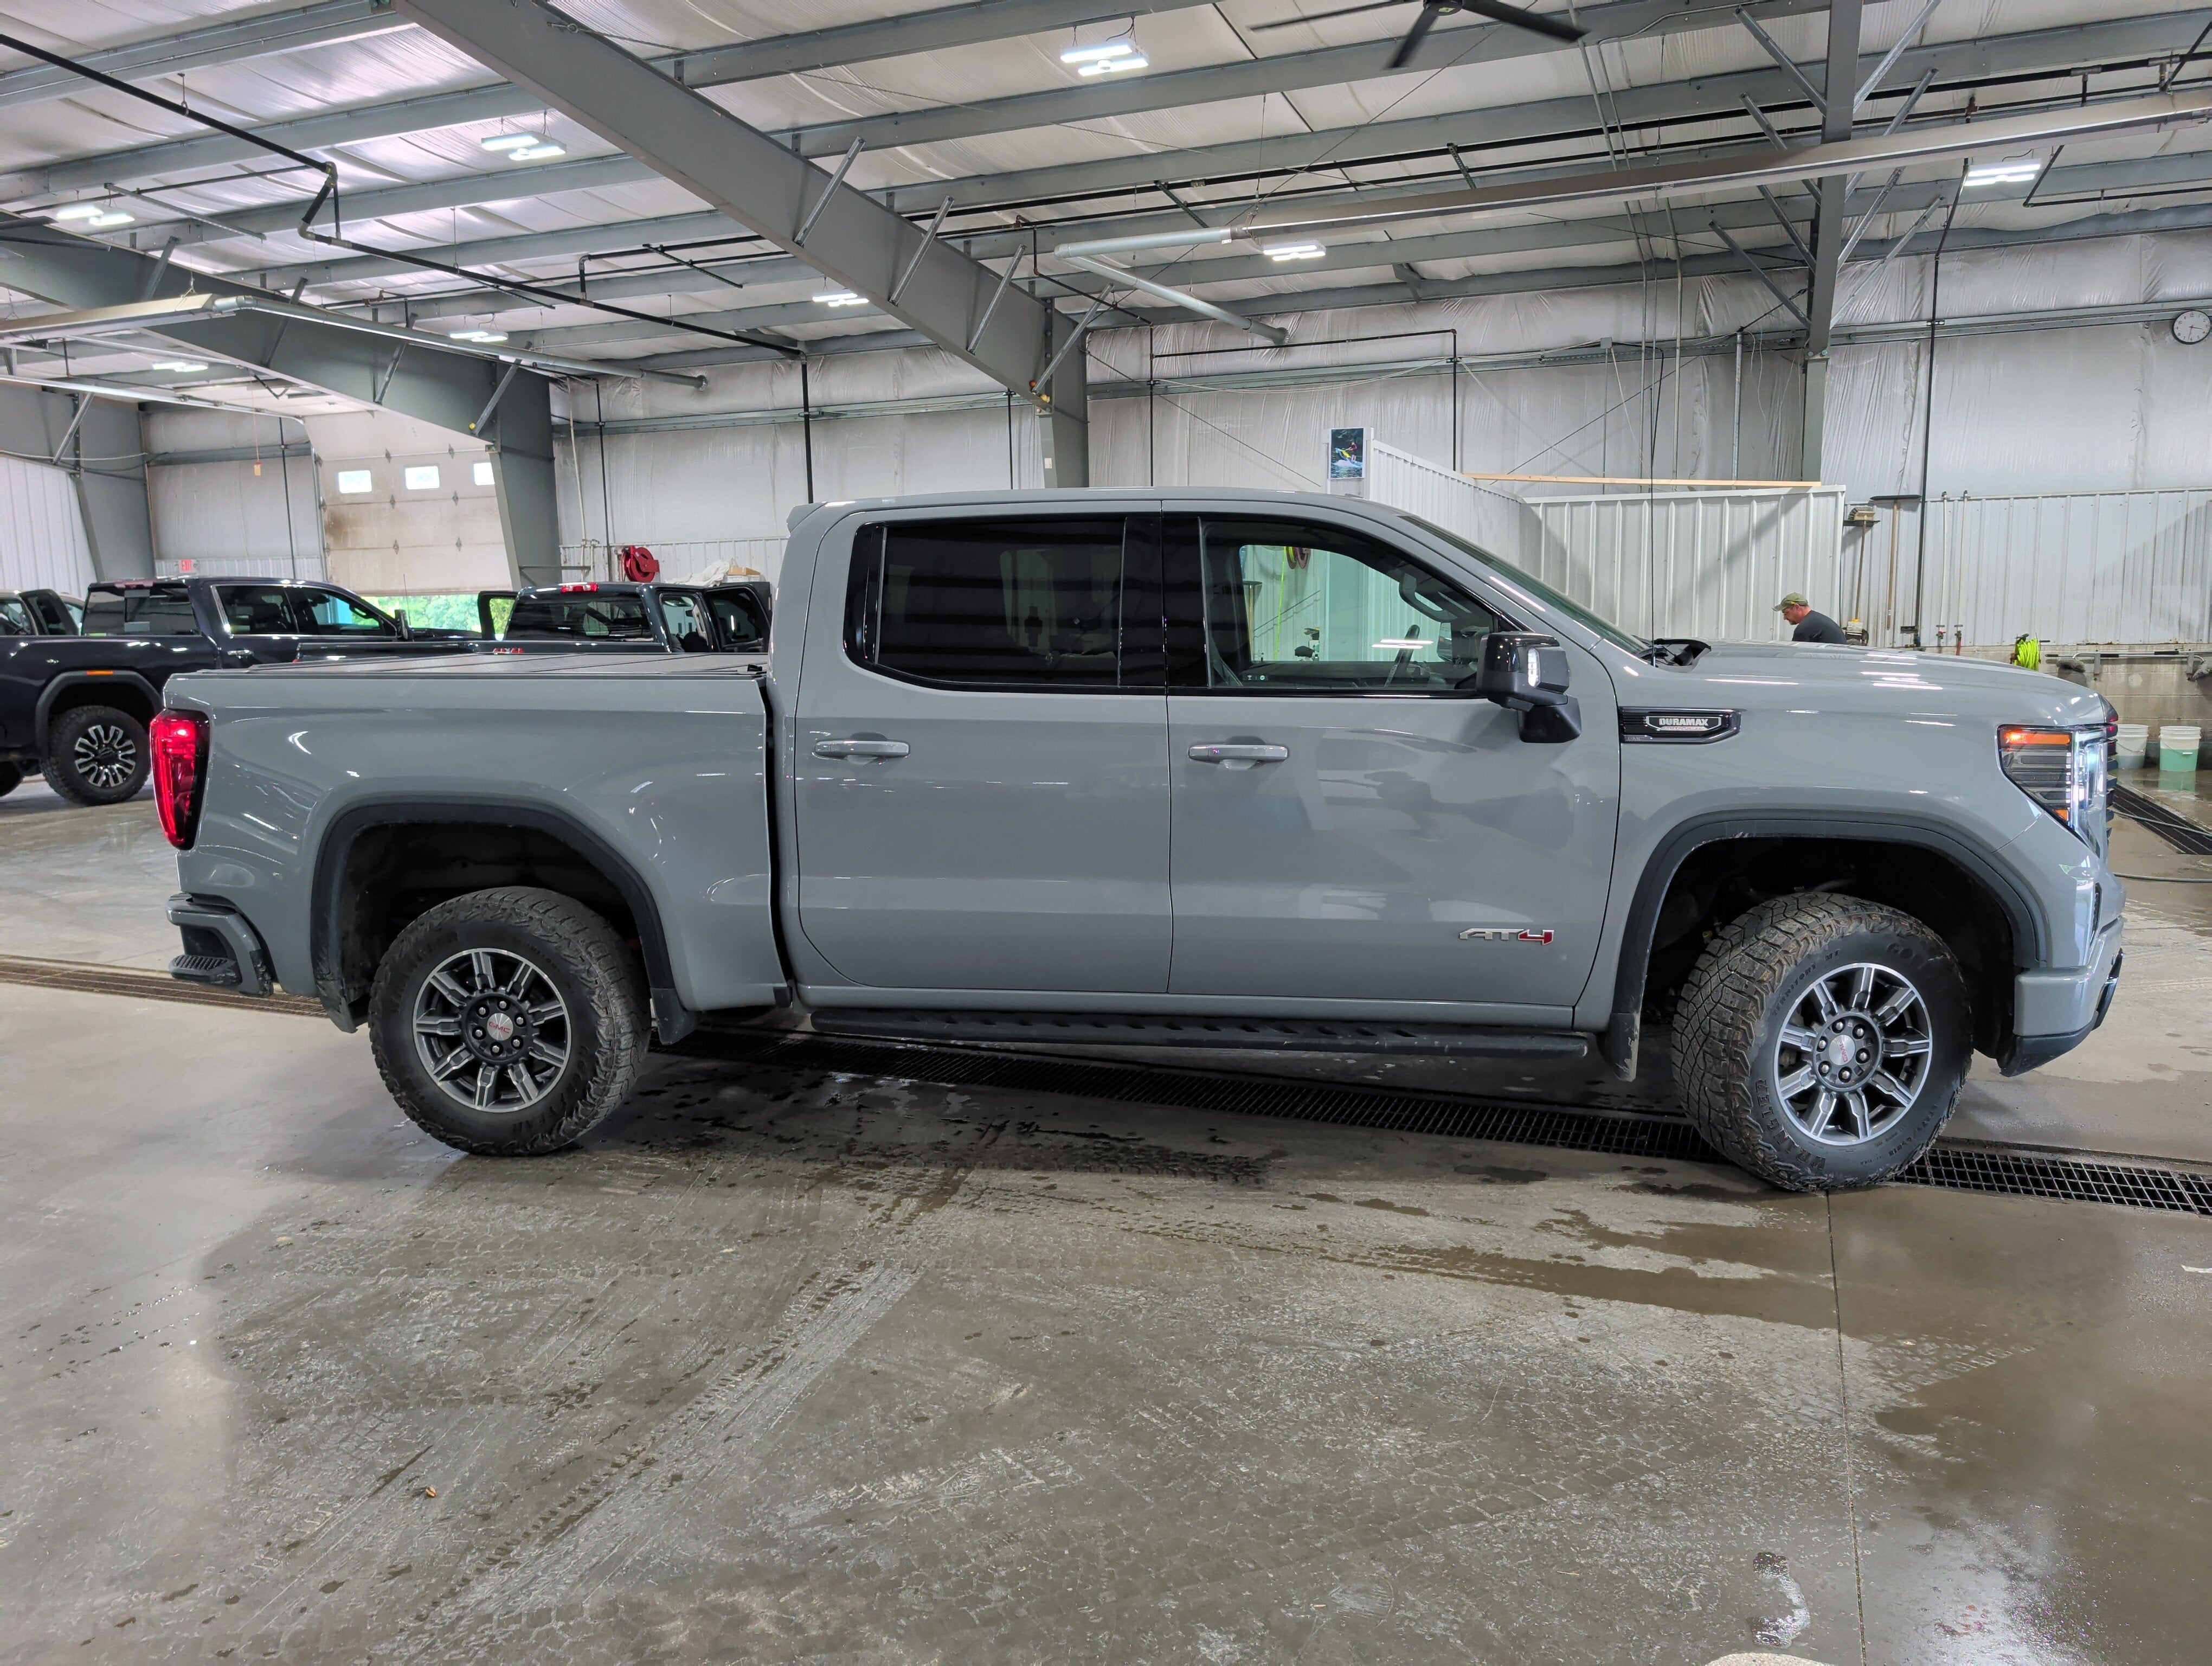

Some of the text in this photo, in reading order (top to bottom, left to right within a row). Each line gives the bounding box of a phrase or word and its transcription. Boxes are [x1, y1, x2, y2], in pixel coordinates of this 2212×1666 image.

[1659, 718, 1708, 726] DURAMAX
[1459, 928, 1554, 946] AT4
[488, 1021, 511, 1034] GMC
[1836, 1039, 1849, 1062] GMC
[1754, 1079, 1827, 1170] WRANGLER
